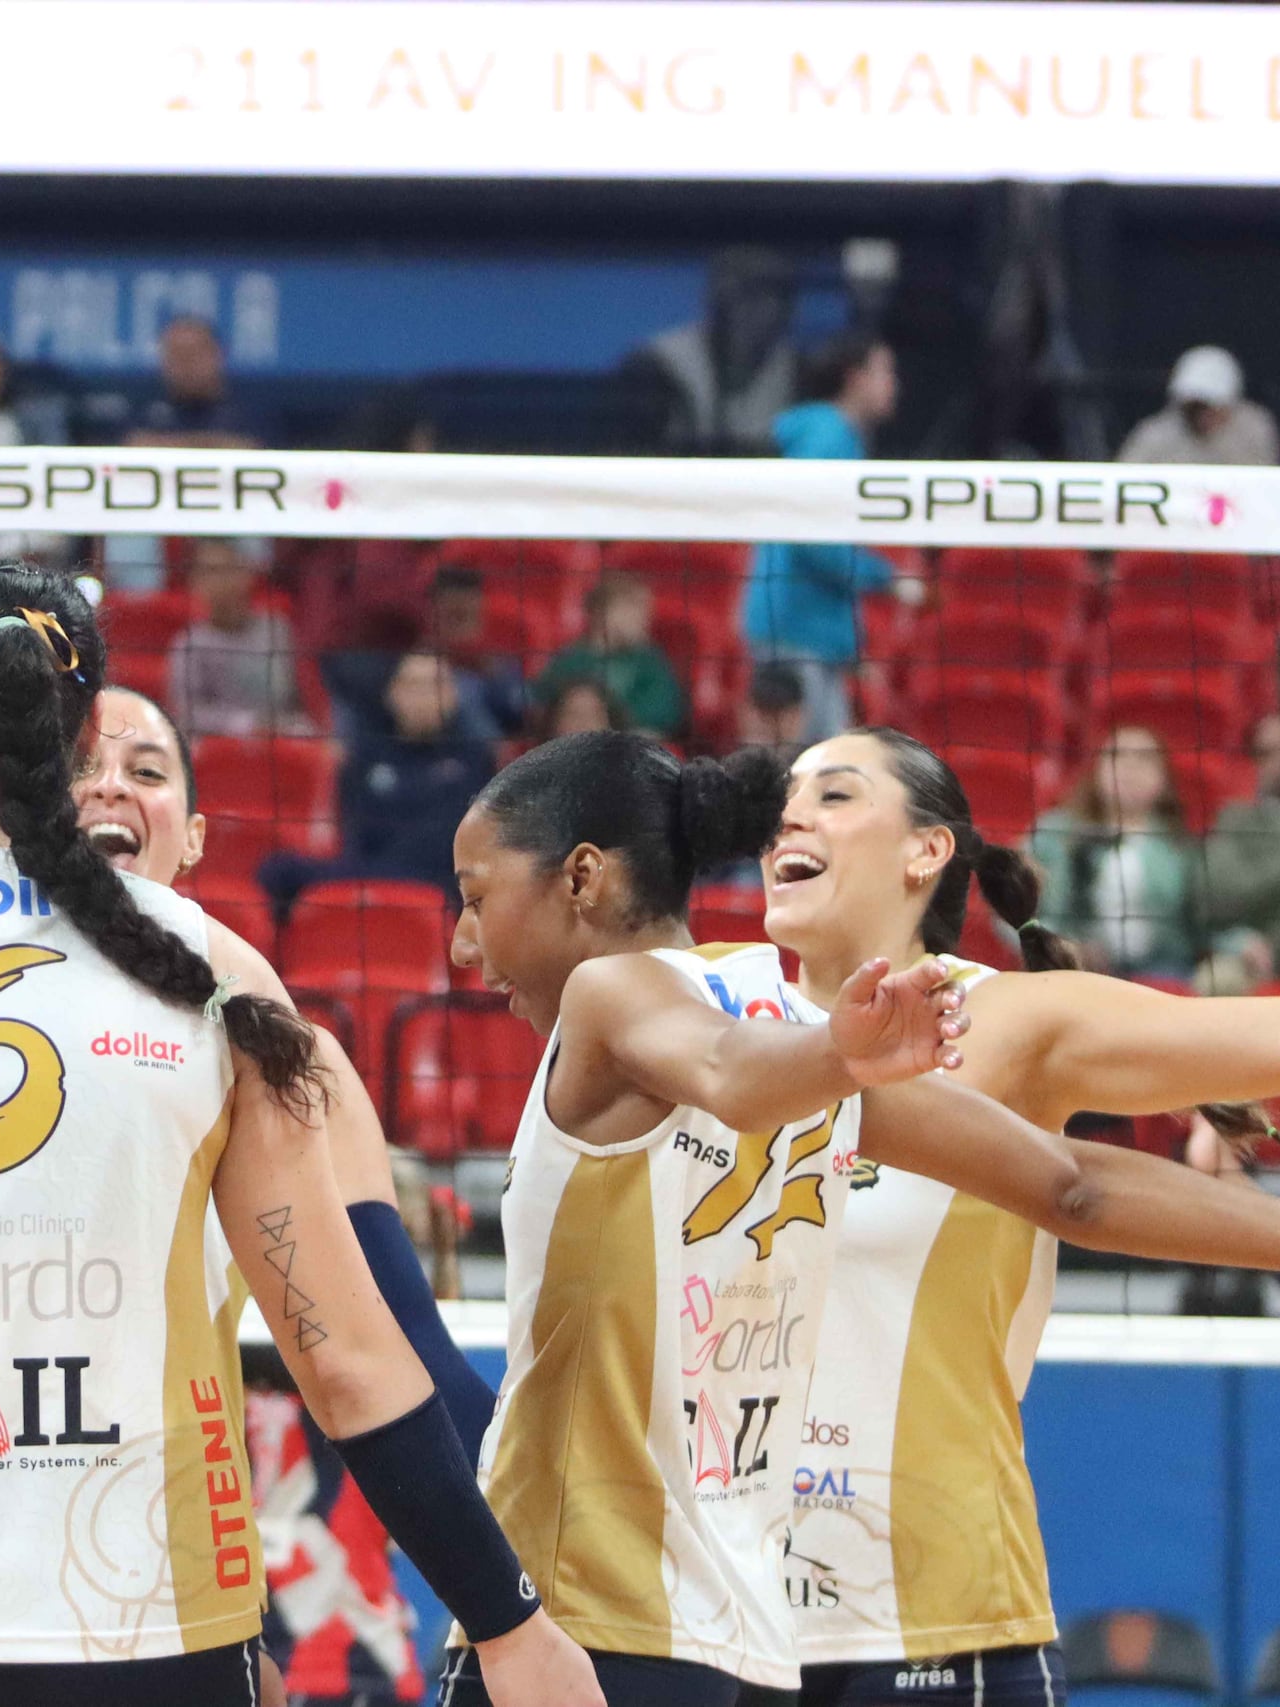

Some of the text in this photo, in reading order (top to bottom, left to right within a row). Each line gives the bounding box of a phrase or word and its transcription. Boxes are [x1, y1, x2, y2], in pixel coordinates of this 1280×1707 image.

[158, 42, 326, 113] 211
[366, 46, 498, 113] AV
[550, 47, 726, 116] ING
[786, 50, 1224, 123] MANUEL
[19, 1457, 90, 1469] Systems,
[95, 1455, 123, 1467] Inc.
[190, 1375, 250, 1590] OTENE
[895, 1669, 956, 1688] errea
